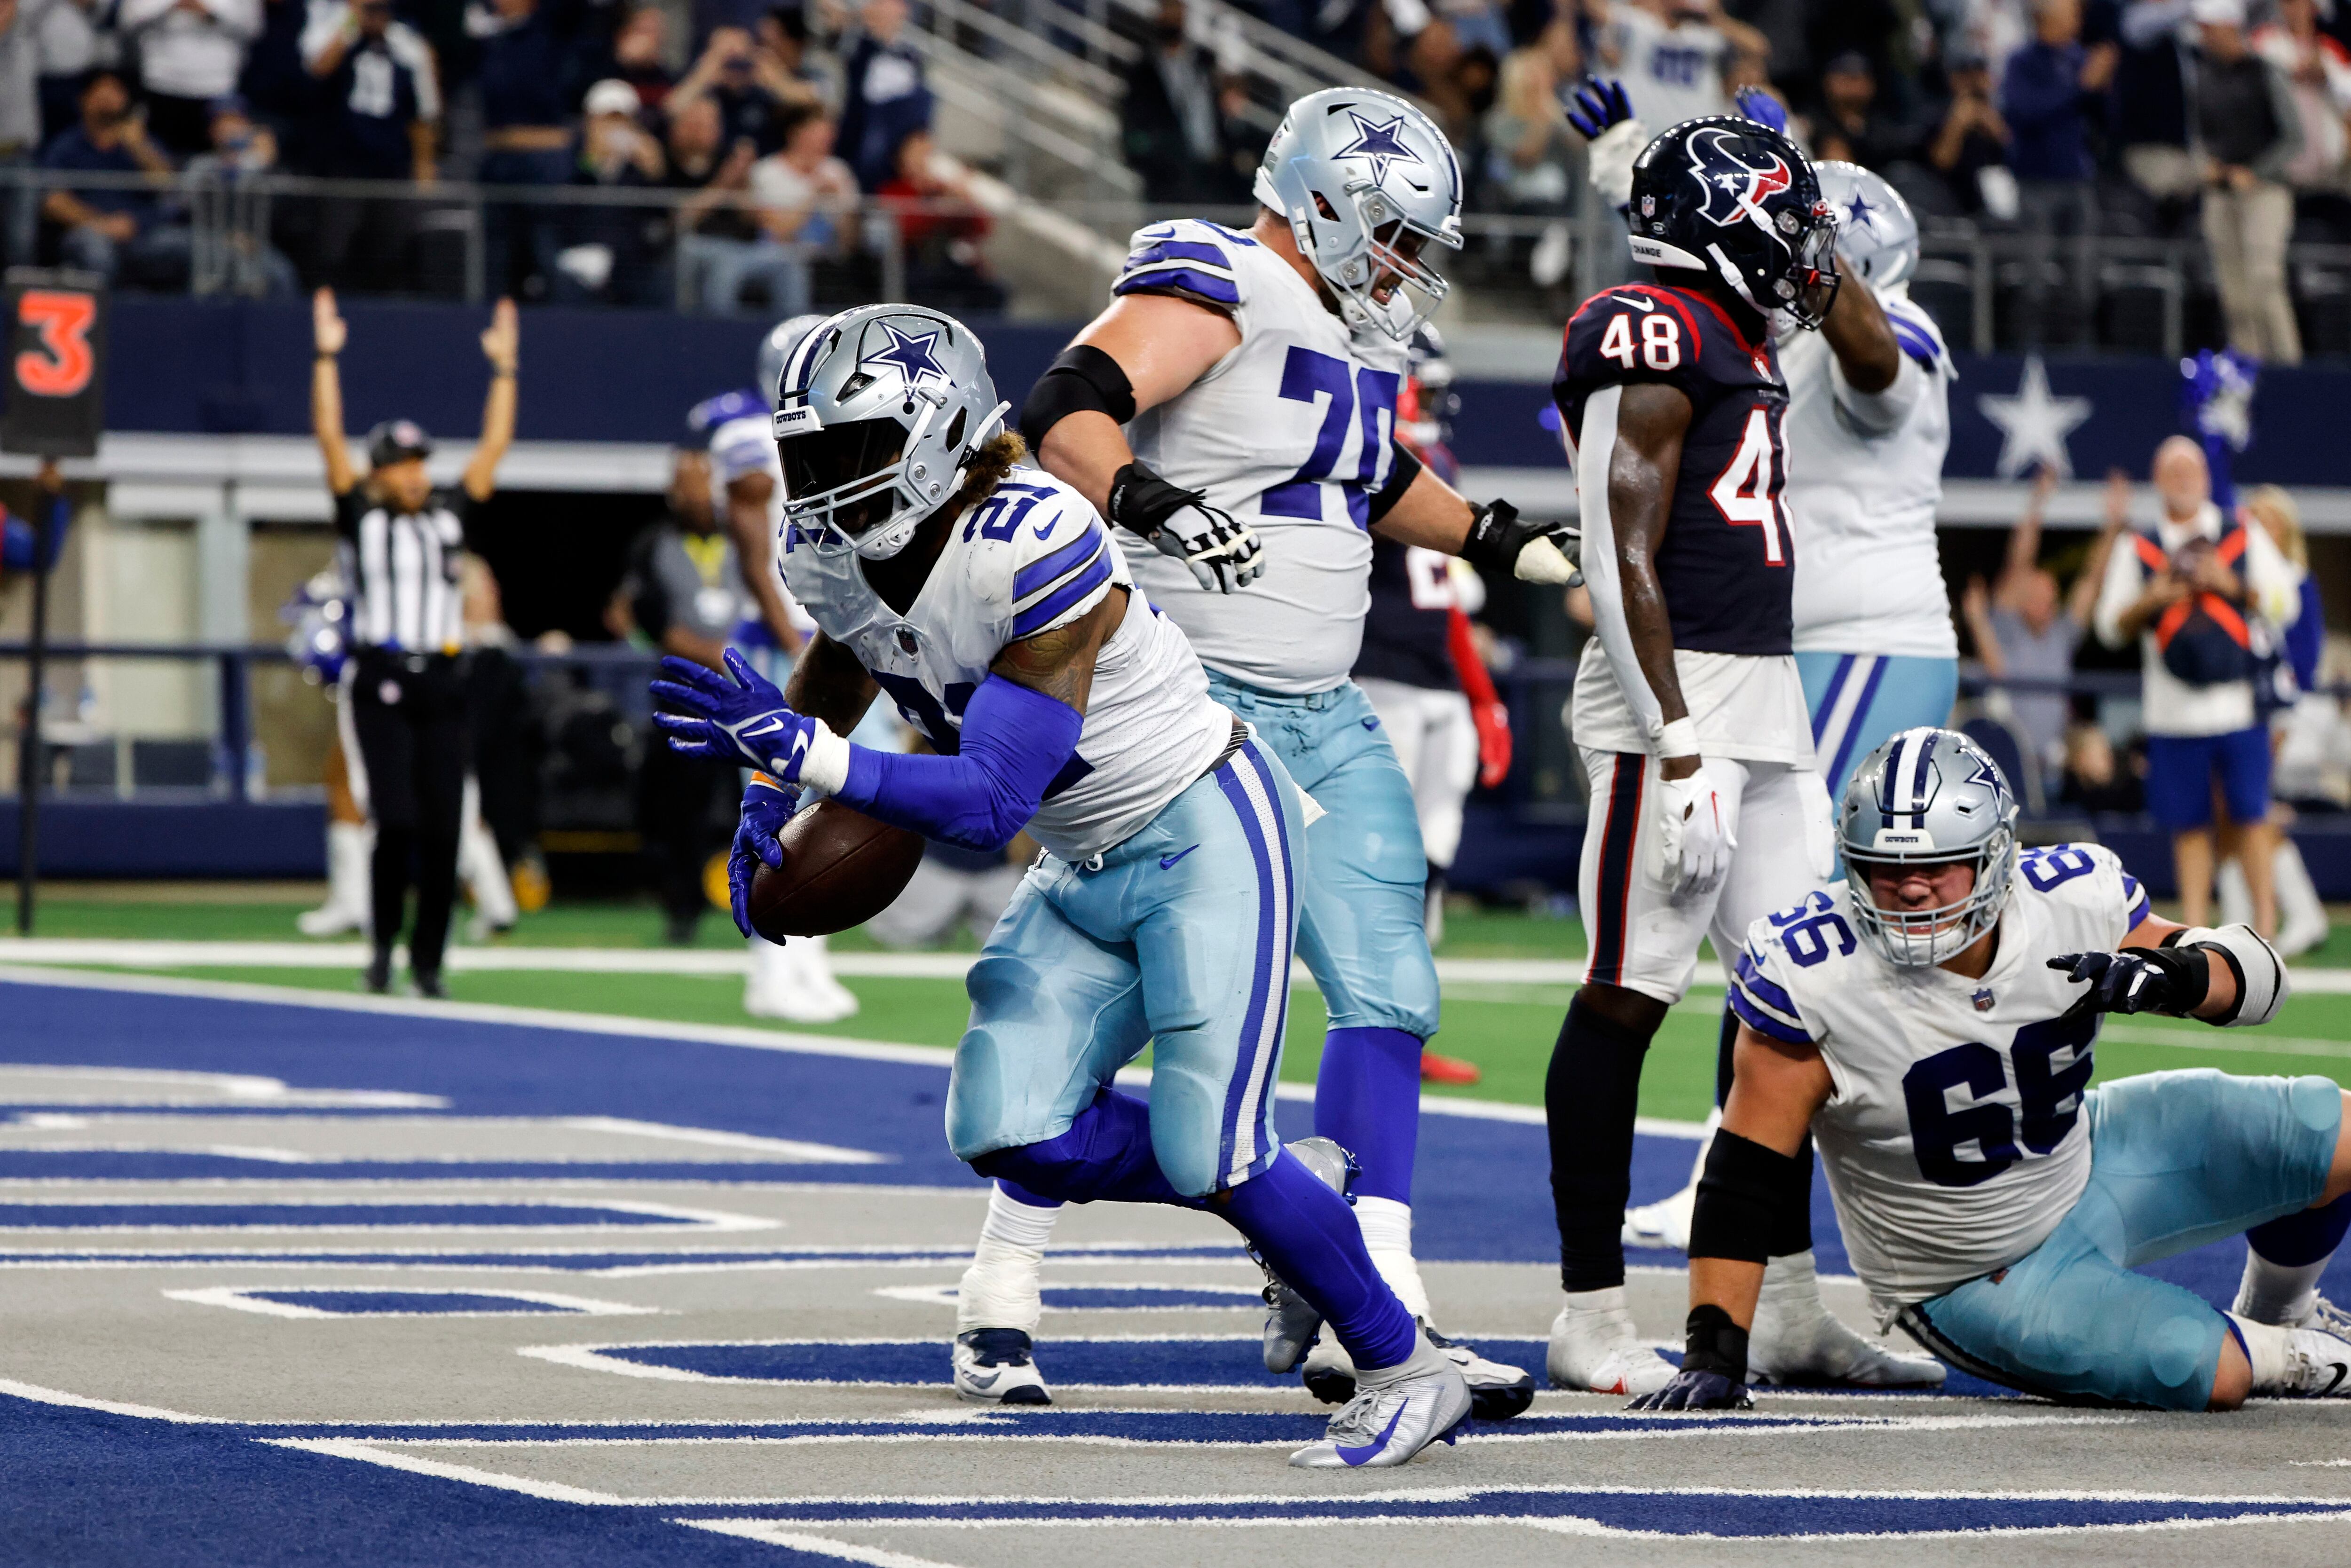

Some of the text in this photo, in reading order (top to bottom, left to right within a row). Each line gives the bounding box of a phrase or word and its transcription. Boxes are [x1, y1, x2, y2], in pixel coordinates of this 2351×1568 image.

[16, 290, 96, 398] 3
[1598, 312, 1681, 371] 48
[776, 410, 806, 424] COWBOYS
[1261, 346, 1400, 532] 70
[963, 483, 1060, 543] 21
[1706, 403, 1797, 567] 4
[1902, 1017, 2093, 1187] 66
